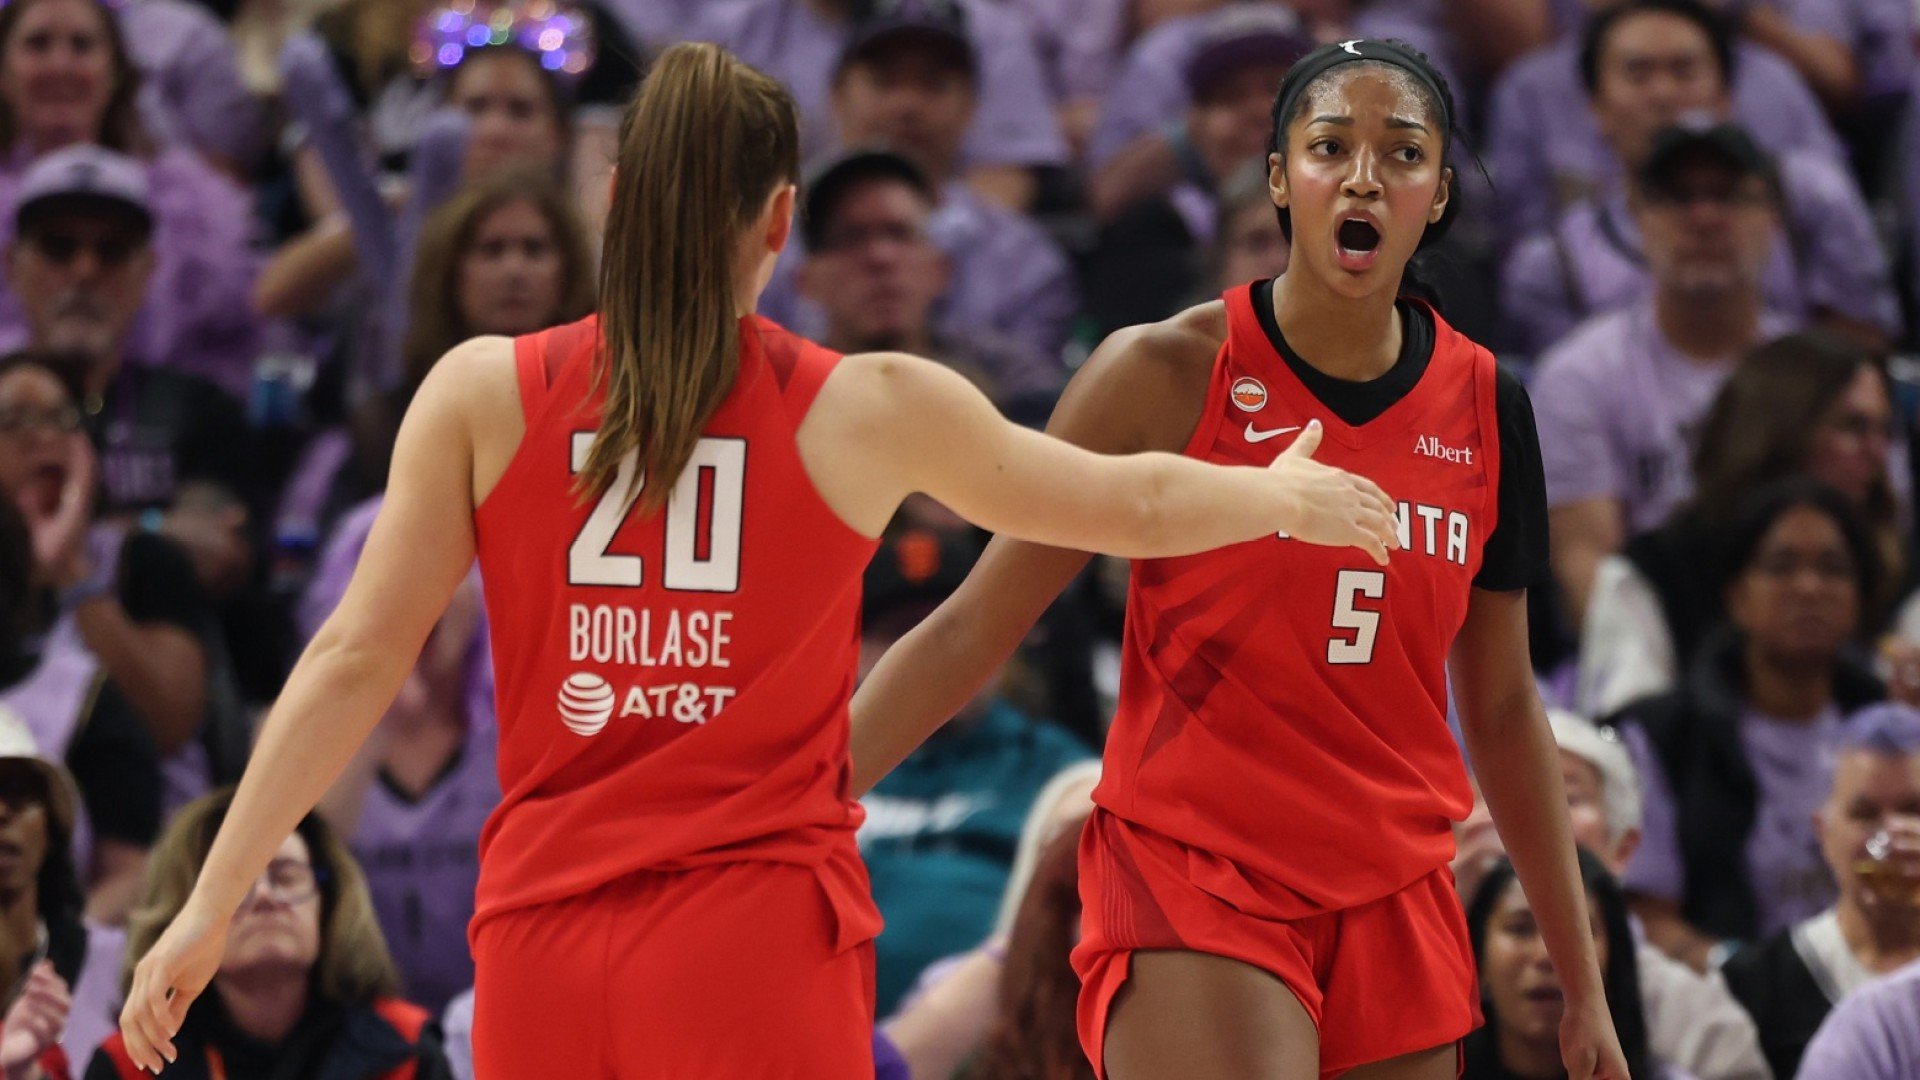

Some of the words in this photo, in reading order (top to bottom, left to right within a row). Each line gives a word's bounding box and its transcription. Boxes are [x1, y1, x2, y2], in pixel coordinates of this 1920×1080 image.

[1413, 434, 1473, 465] Albert
[568, 430, 747, 593] 20
[569, 603, 734, 668] BORLASE
[1327, 568, 1386, 665] 5
[619, 682, 736, 724] AT&T
